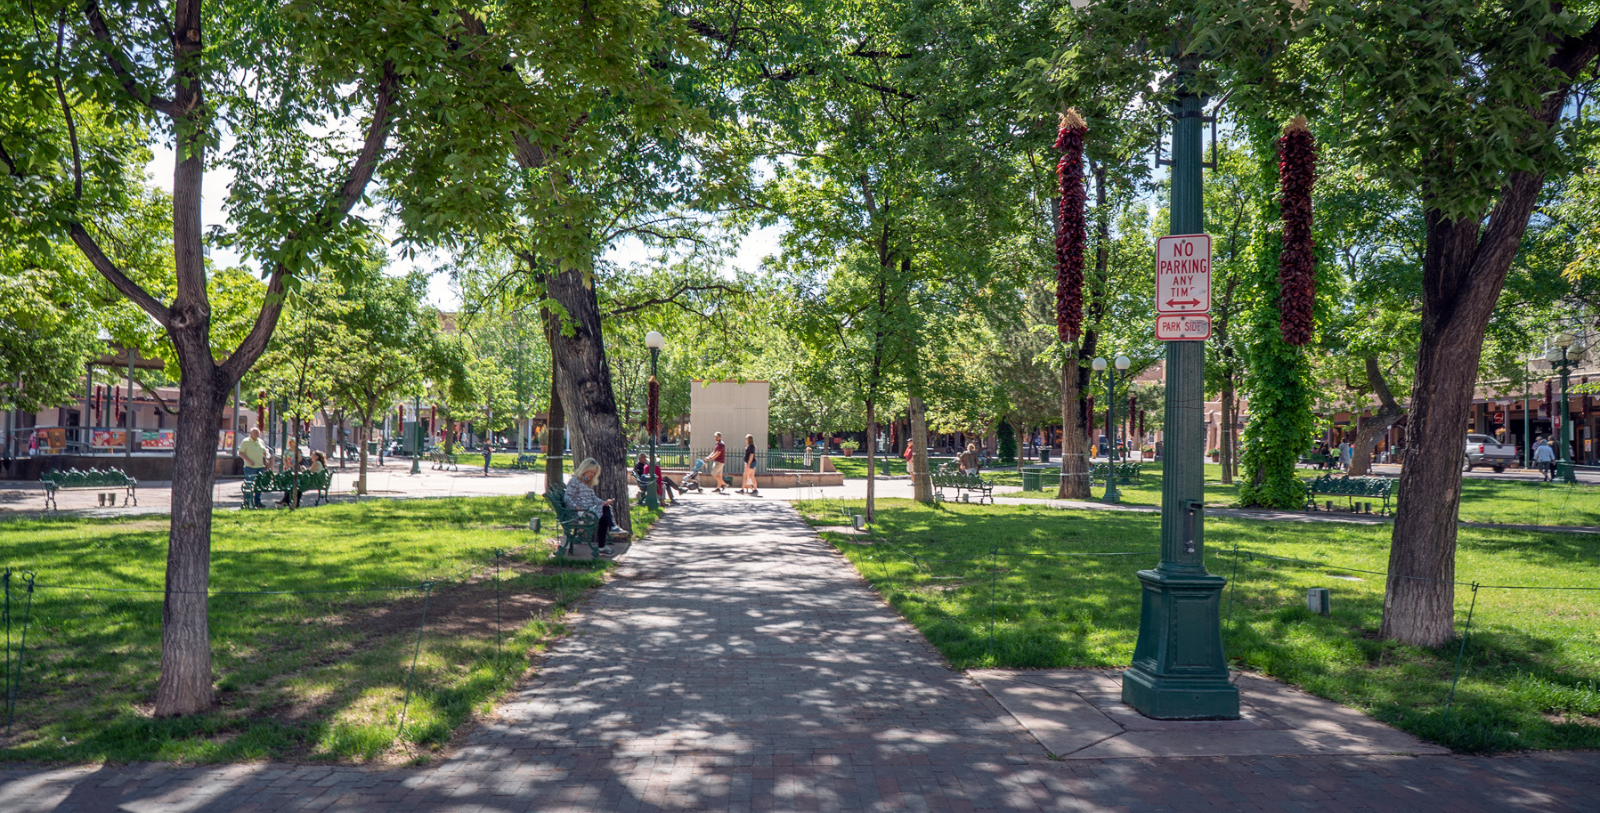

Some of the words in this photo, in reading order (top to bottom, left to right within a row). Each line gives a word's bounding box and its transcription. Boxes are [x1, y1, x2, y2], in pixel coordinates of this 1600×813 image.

[1173, 242, 1194, 257] NO
[1160, 258, 1207, 275] PARKING
[1172, 275, 1194, 286] ANY
[1170, 286, 1196, 298] TIM
[1162, 321, 1182, 332] PARK
[1184, 321, 1202, 332] SIDE
